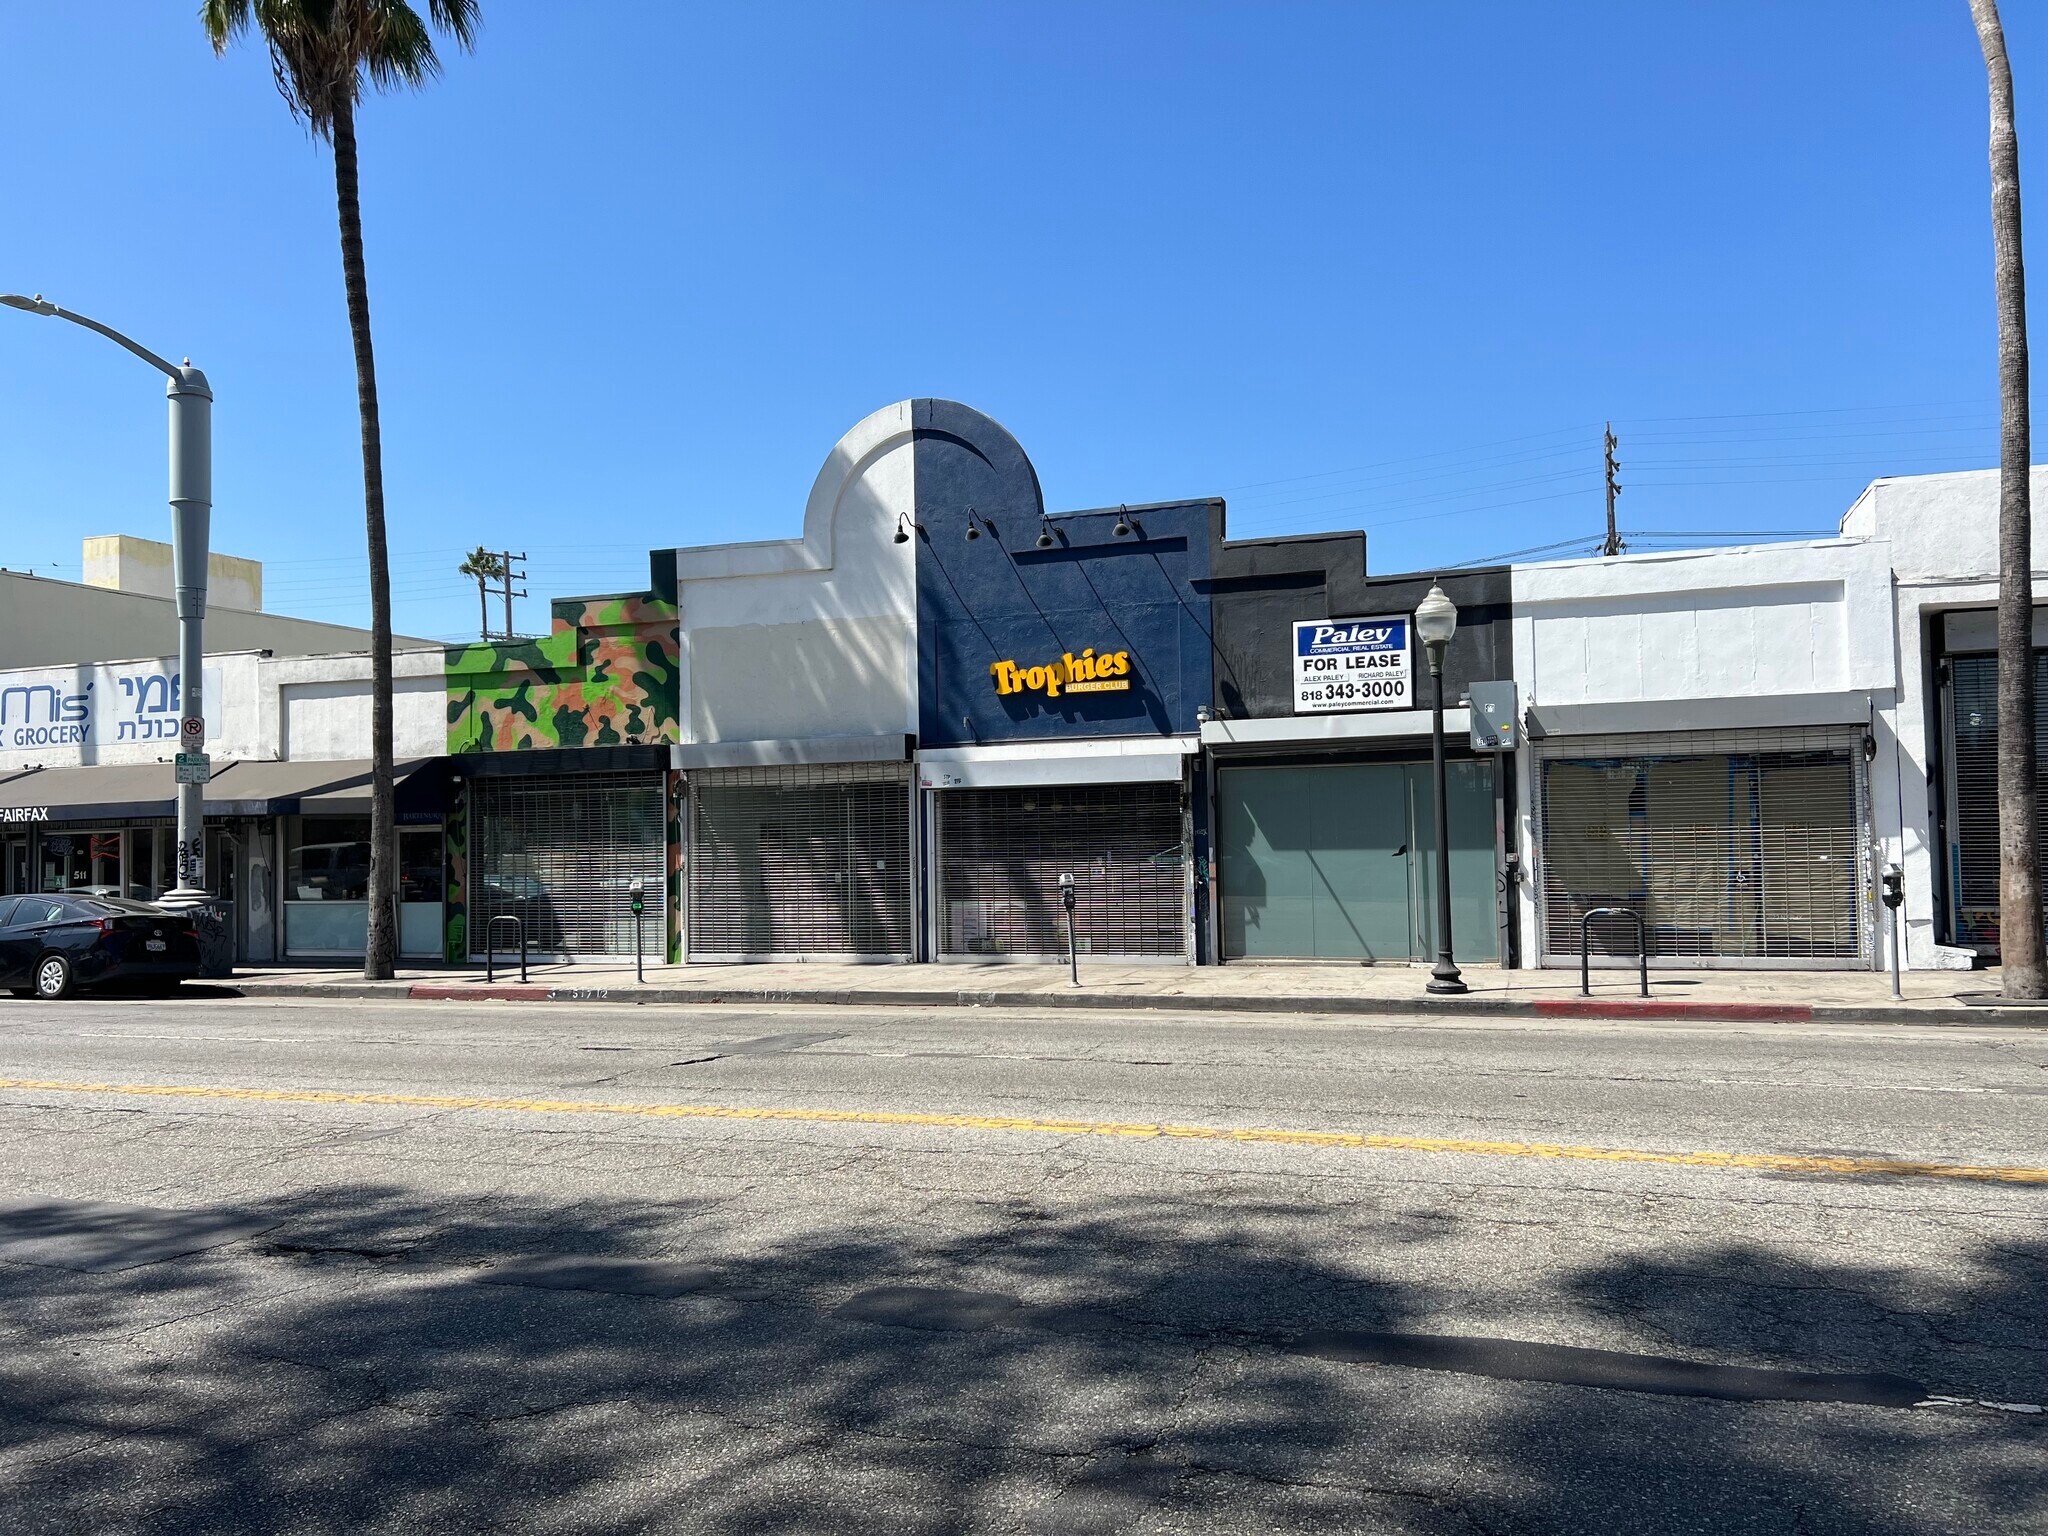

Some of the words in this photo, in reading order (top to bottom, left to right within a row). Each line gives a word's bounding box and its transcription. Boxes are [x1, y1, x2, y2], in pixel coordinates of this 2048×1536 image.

[1312, 625, 1393, 647] Paley
[1310, 646, 1351, 654] COMMERCIAL
[1304, 658, 1338, 671] FOR
[1346, 654, 1401, 669] LEASE
[990, 648, 1130, 697] Trophies
[1066, 682, 1101, 691] BURGER
[1105, 680, 1128, 689] CLUB
[1301, 691, 1322, 701] 818
[1325, 680, 1404, 699] 343-3000
[1312, 699, 1394, 708] www.paleycommercial.com
[14, 725, 90, 745] GROCERY
[73, 870, 87, 880] 511
